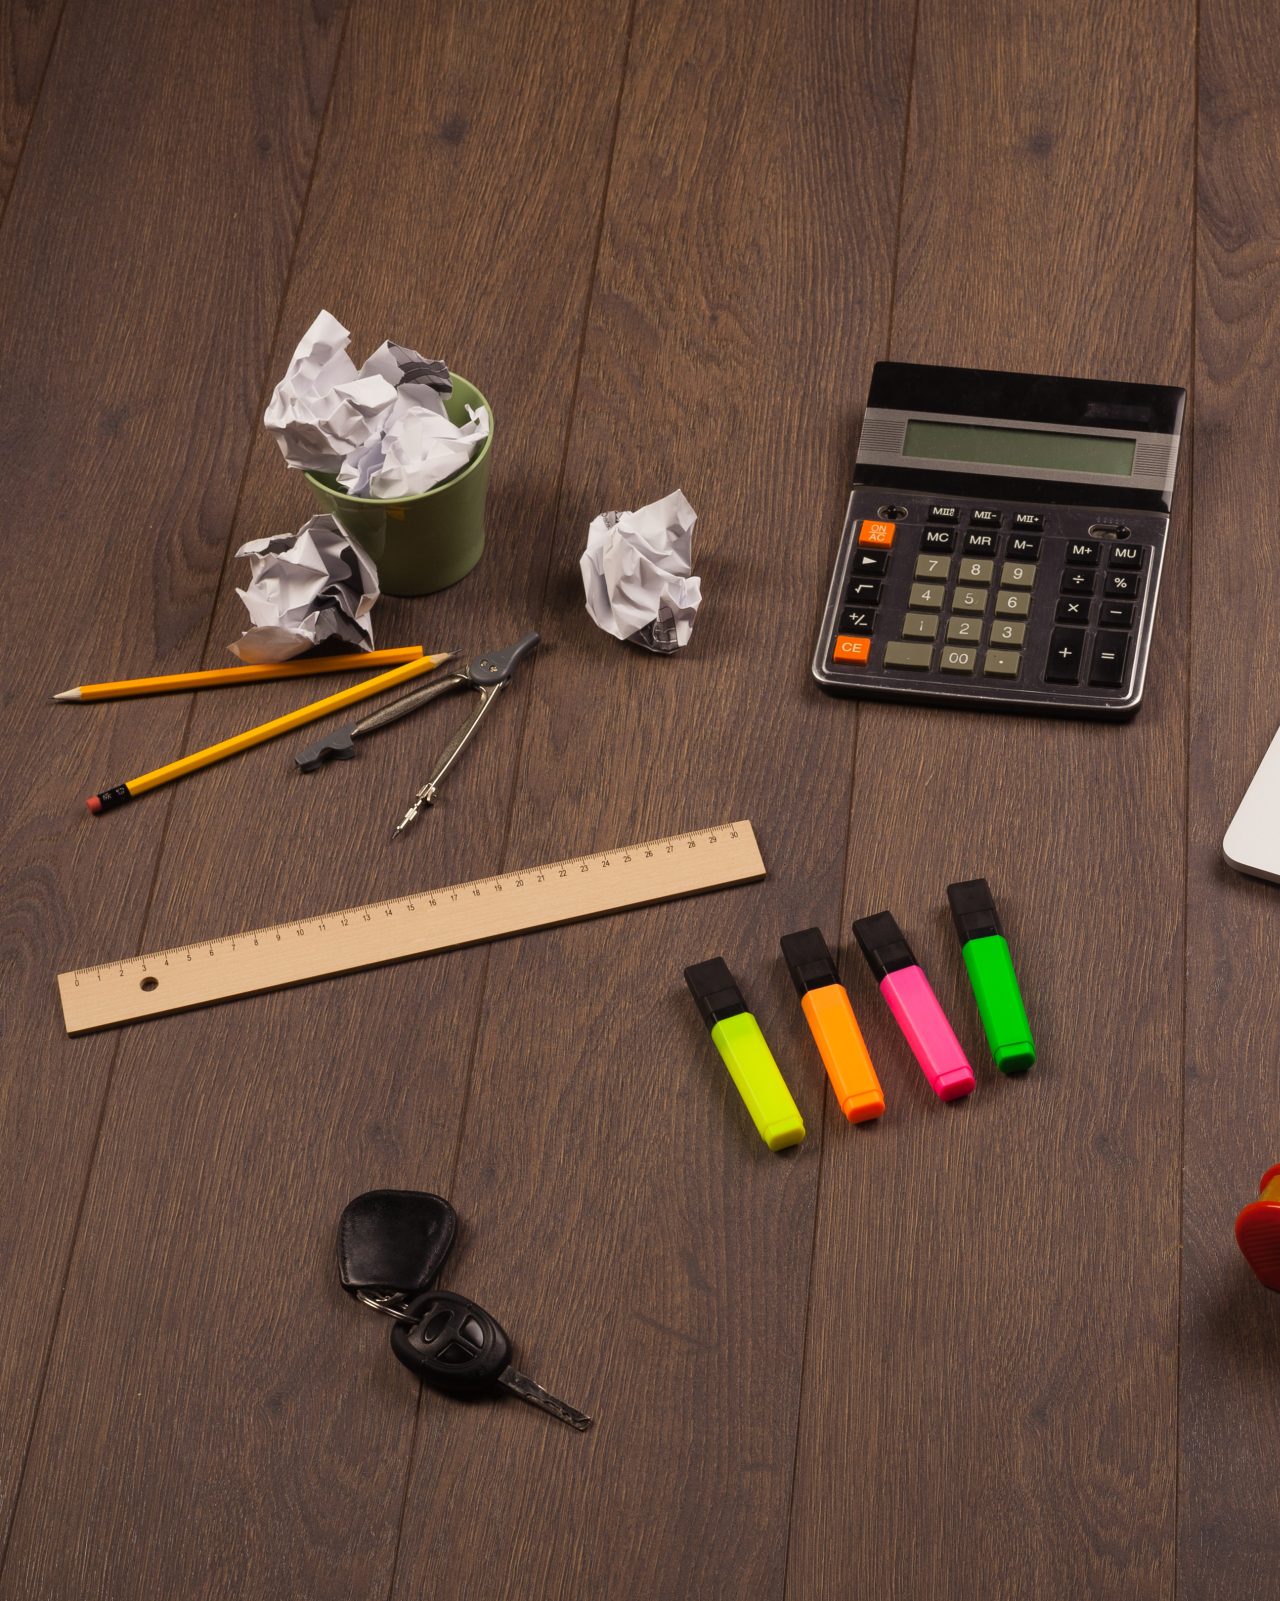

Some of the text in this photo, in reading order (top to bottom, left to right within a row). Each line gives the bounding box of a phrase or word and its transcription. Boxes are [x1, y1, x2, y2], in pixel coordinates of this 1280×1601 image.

[869, 531, 886, 540] AC
[871, 525, 886, 533] ON
[926, 531, 949, 542] MC
[969, 534, 991, 545] MR
[1072, 544, 1092, 555] M+
[1114, 547, 1136, 558] MU
[928, 559, 1023, 579] 7 8 9
[921, 589, 1017, 608] 4 5 6
[958, 622, 1012, 638] 2 3
[841, 642, 862, 652] CE
[948, 652, 968, 664] 00
